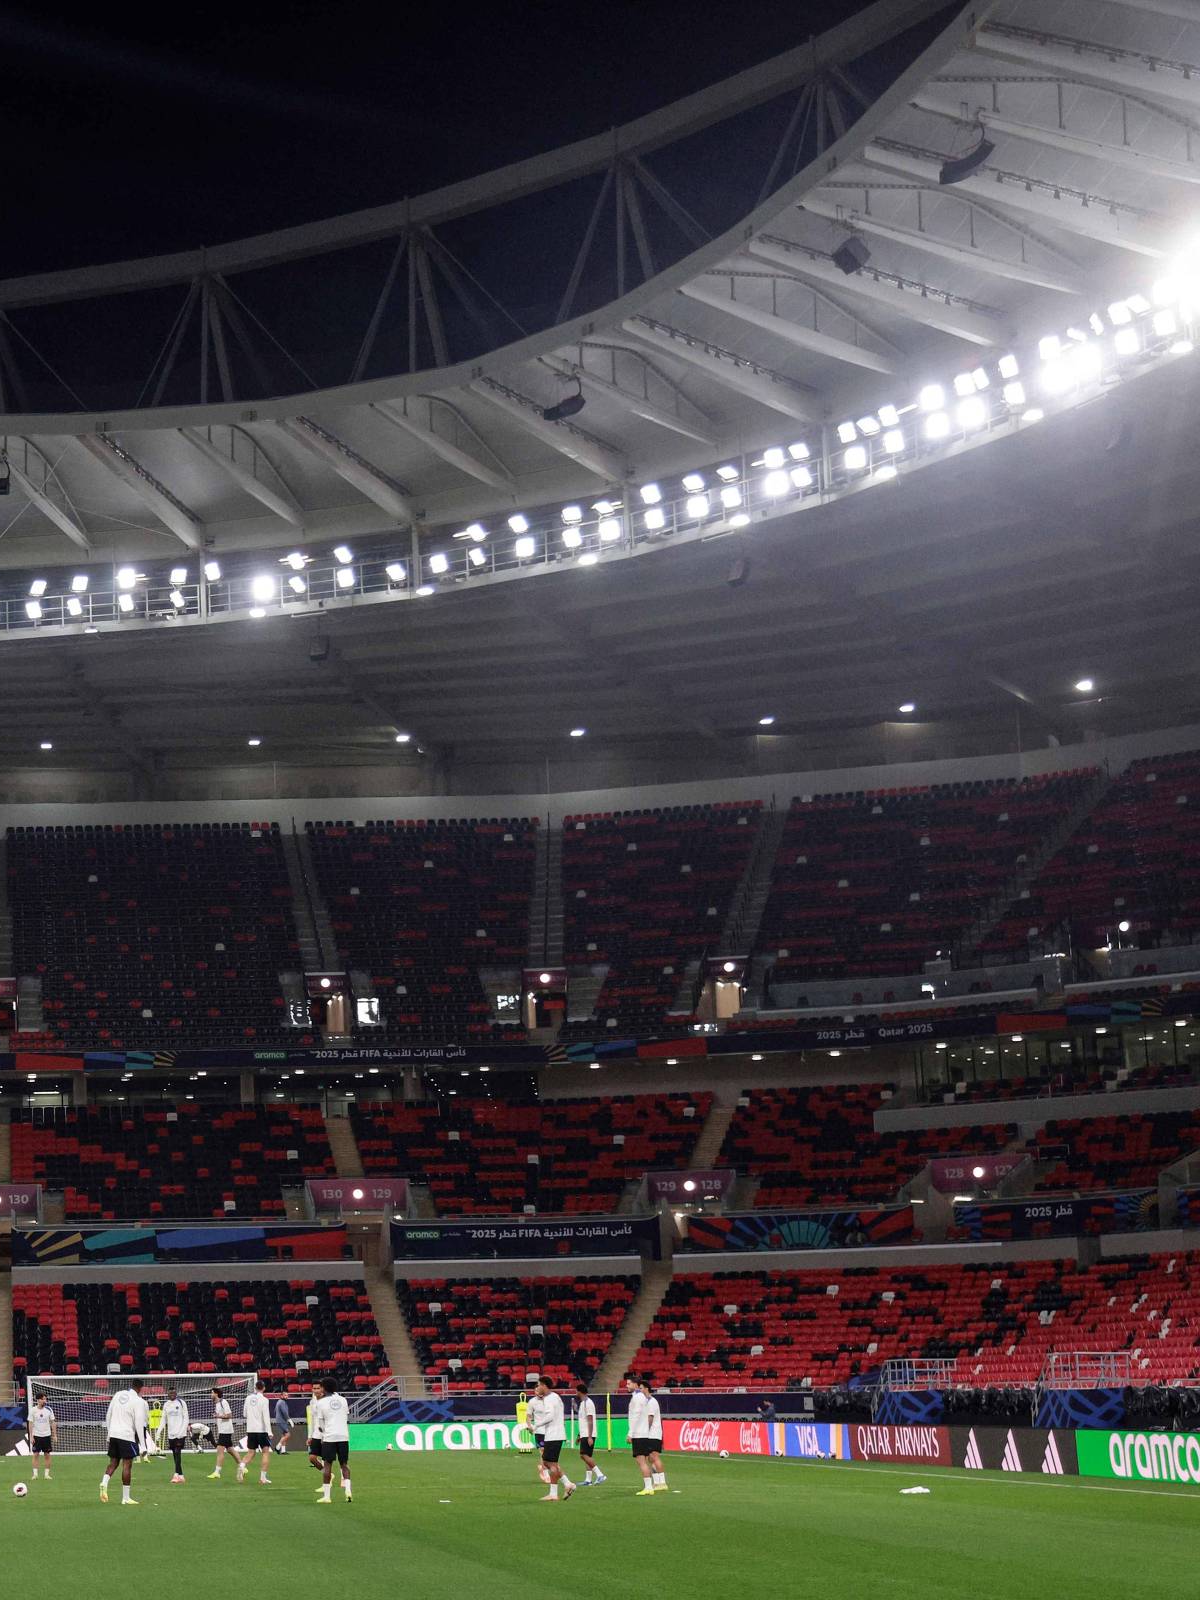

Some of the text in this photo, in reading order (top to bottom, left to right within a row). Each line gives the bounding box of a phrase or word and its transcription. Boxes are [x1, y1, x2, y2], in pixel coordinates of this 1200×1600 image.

[816, 1029, 865, 1040] قطر 2025
[878, 1023, 933, 1037] Qatar 2025
[360, 1049, 381, 1058] FIFA
[9, 1194, 29, 1204] 130
[322, 1189, 392, 1199] 130 129
[1024, 1206, 1052, 1218] 2025
[406, 1231, 439, 1239] aramco
[518, 1229, 541, 1238] FIFA
[795, 1425, 819, 1456] VISA
[857, 1425, 939, 1460] QATAR AIRWAYS
[1109, 1432, 1200, 1483] aramco
